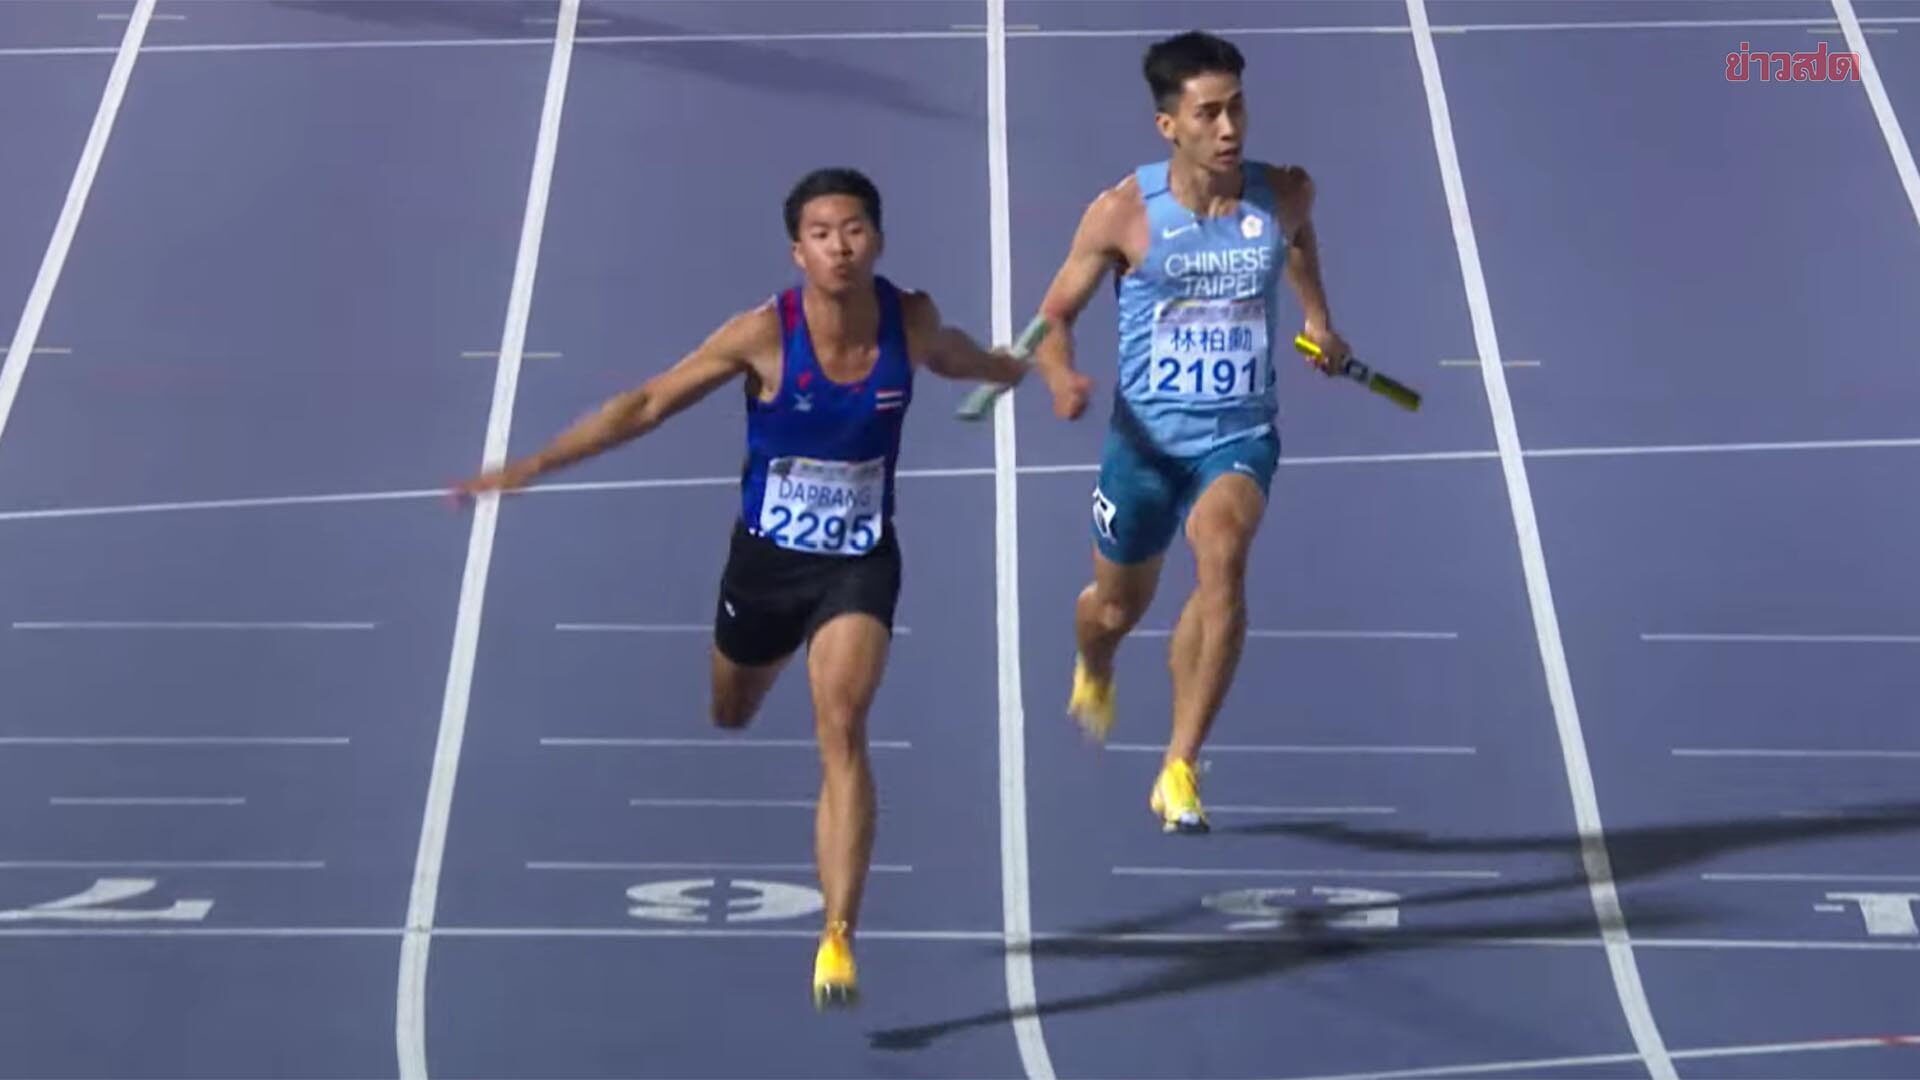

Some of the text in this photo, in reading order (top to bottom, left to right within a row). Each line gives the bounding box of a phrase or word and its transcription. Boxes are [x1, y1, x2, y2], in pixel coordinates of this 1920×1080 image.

[1165, 246, 1271, 277] CHINESE
[1180, 272, 1257, 296] TAIPEI
[1157, 357, 1257, 395] 2191
[768, 505, 875, 551] 2295
[0, 878, 215, 921] 7
